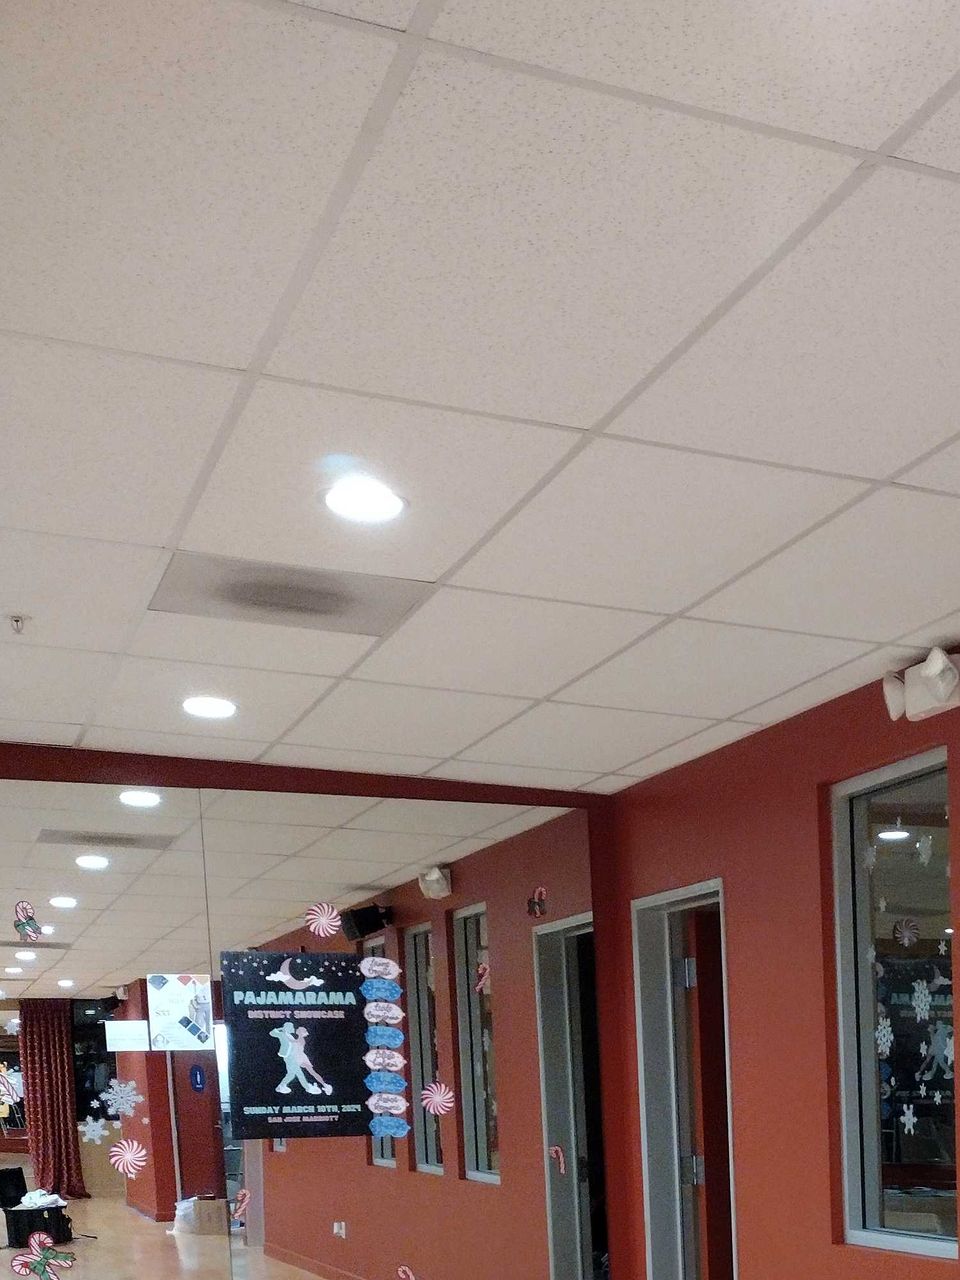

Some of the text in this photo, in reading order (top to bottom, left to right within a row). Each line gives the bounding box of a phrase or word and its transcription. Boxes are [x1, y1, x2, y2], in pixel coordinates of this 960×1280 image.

[233, 991, 356, 1005] PAJAMARAMA
[247, 1010, 345, 1019] DISTRICT SHOWCASE
[243, 1106, 280, 1115] SUNDAY
[282, 1105, 315, 1114] MARCH
